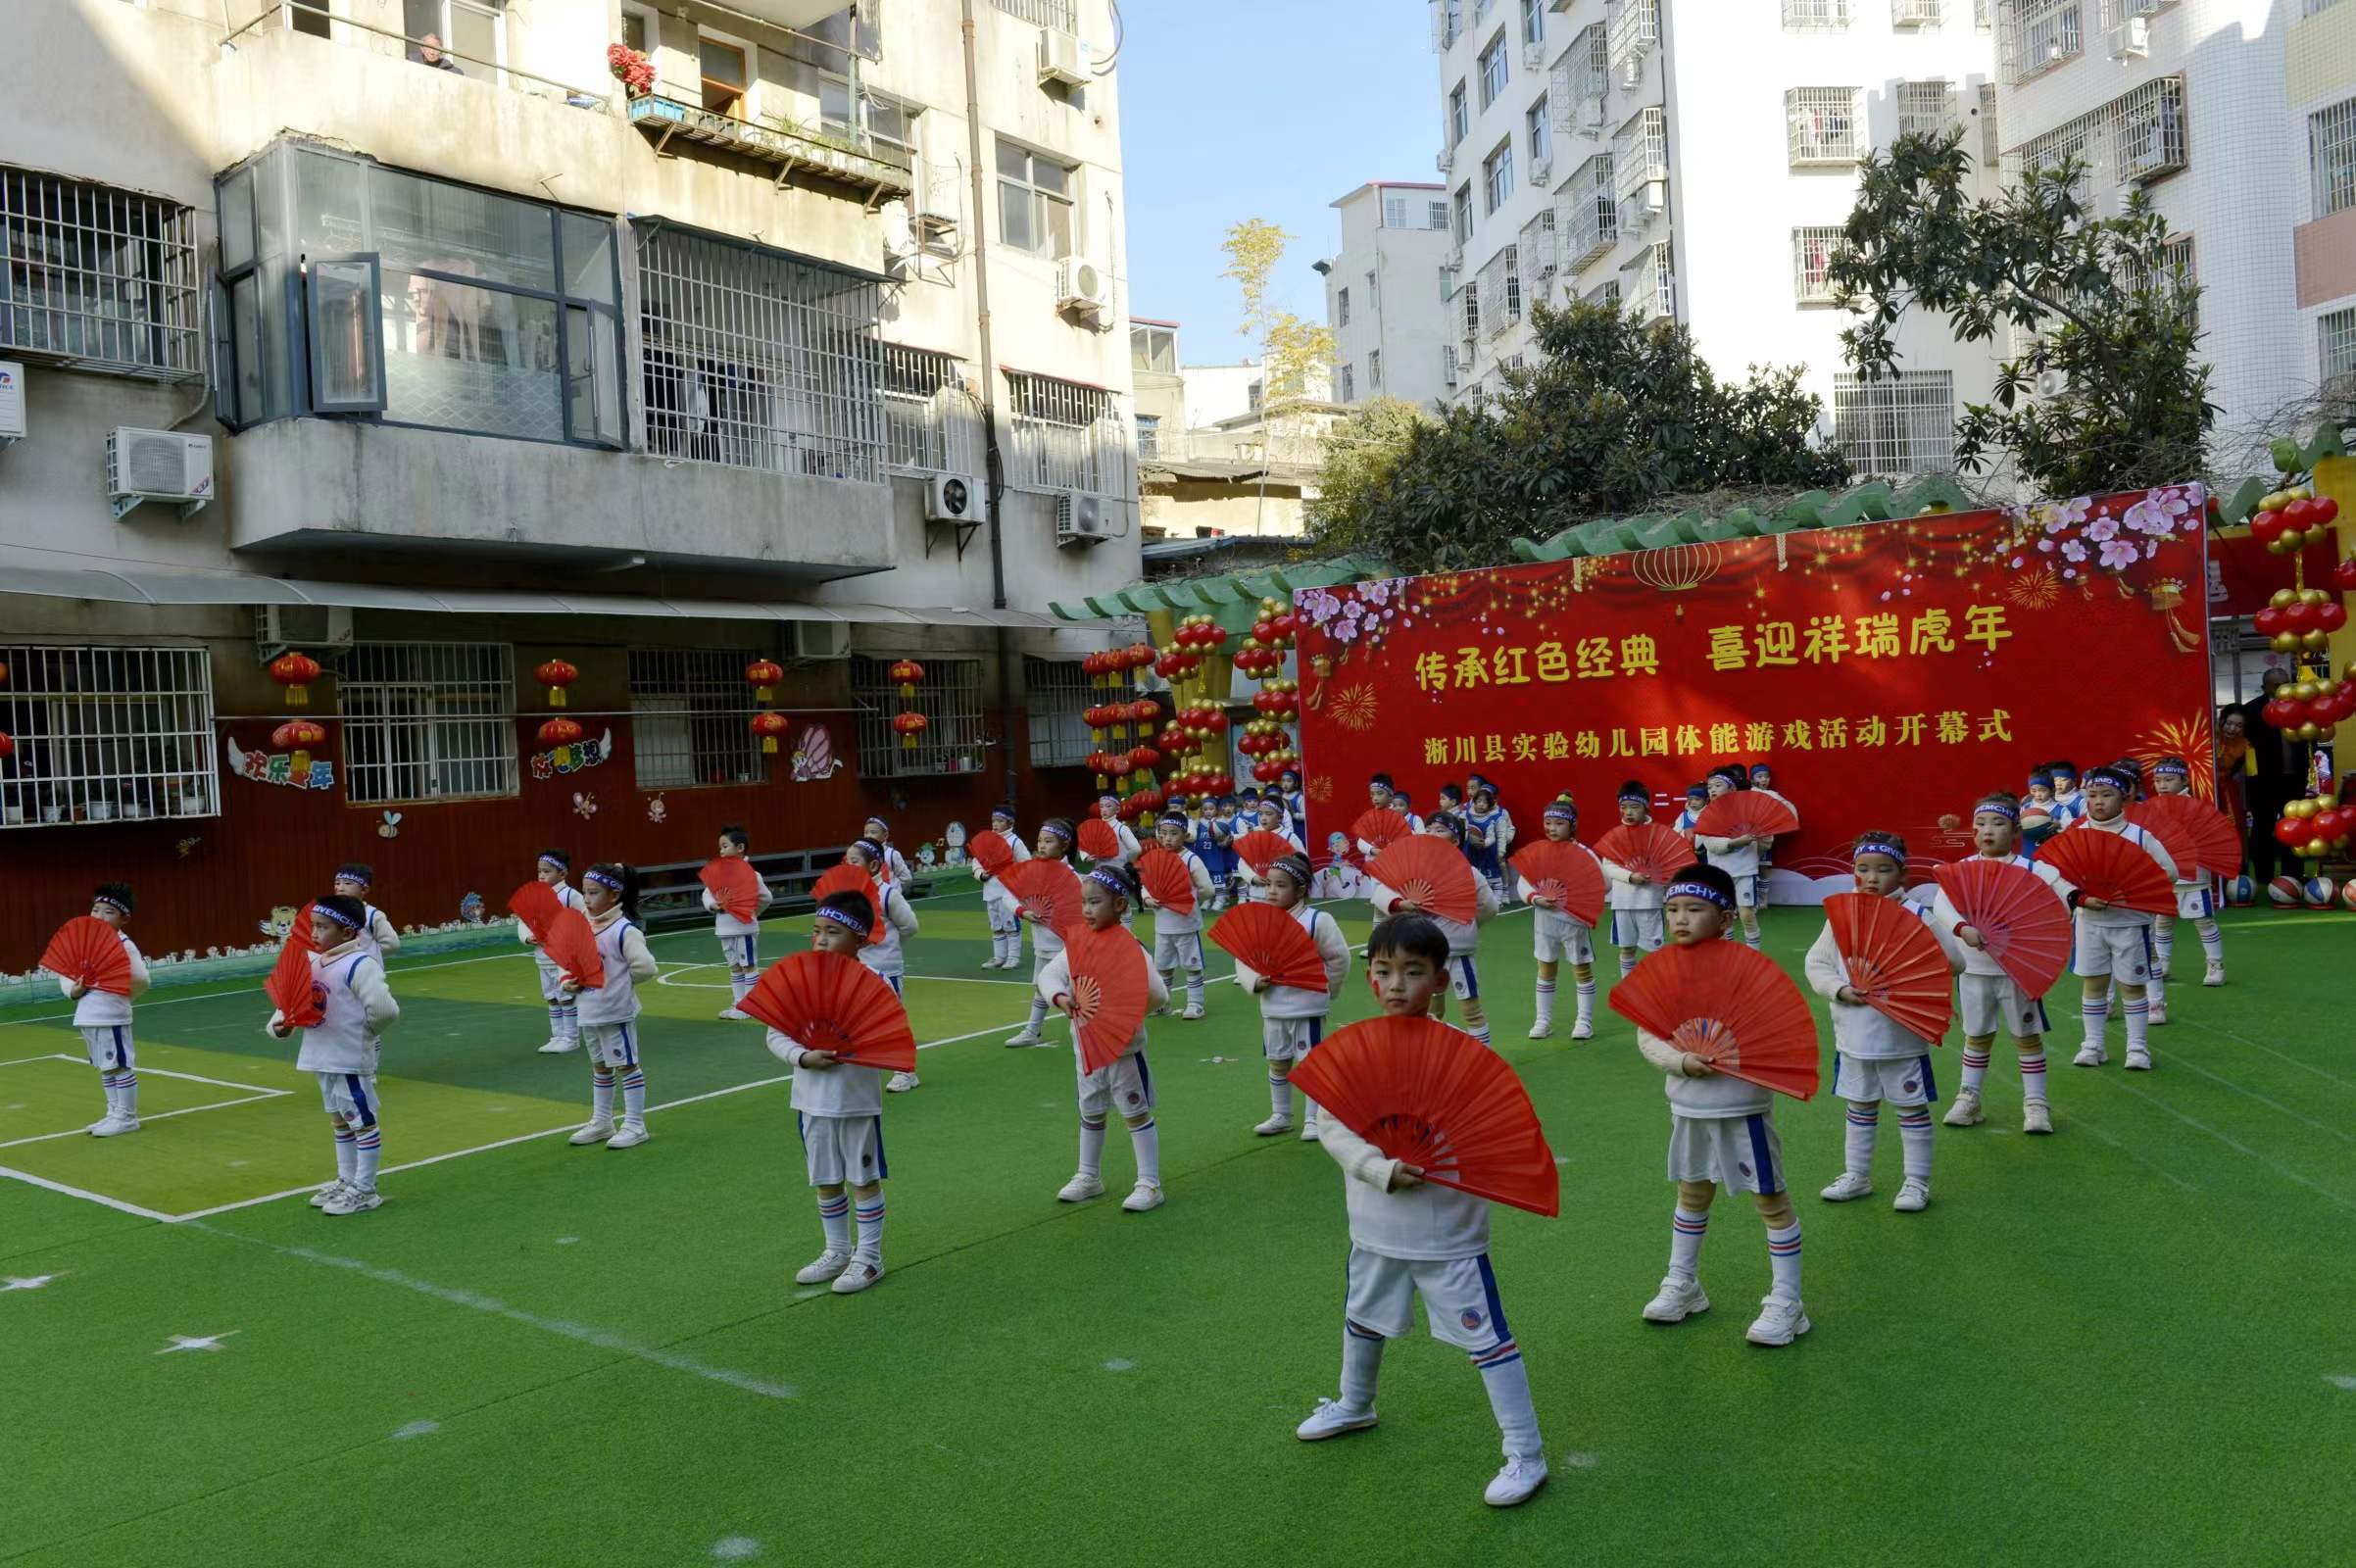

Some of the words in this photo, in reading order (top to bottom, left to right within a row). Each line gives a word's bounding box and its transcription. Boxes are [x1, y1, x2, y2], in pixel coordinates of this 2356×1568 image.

[1415, 633, 1659, 690] 传承红色经典
[1705, 605, 2012, 671] 喜迎祥瑞虎年
[1424, 709, 2012, 764] 淅川县实验幼儿园体能游戏活动开幕式
